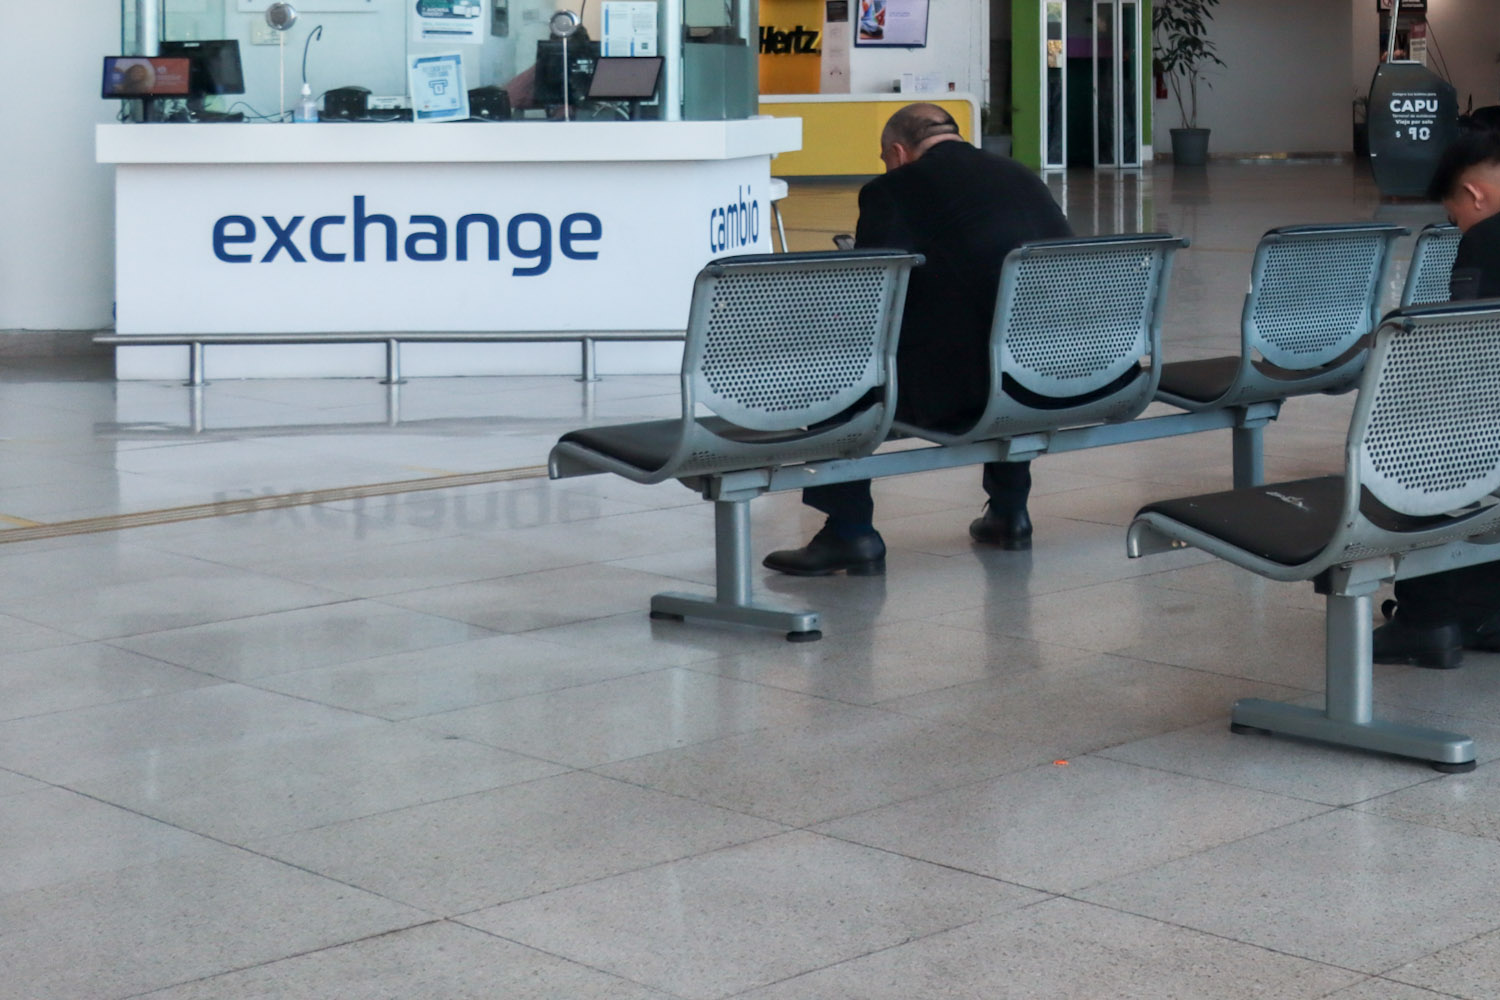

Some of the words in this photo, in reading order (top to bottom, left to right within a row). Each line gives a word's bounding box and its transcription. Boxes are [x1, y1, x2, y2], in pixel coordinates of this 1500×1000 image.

[1390, 99, 1438, 113] CAPU
[212, 195, 603, 277] exchange
[709, 185, 760, 254] cambio
